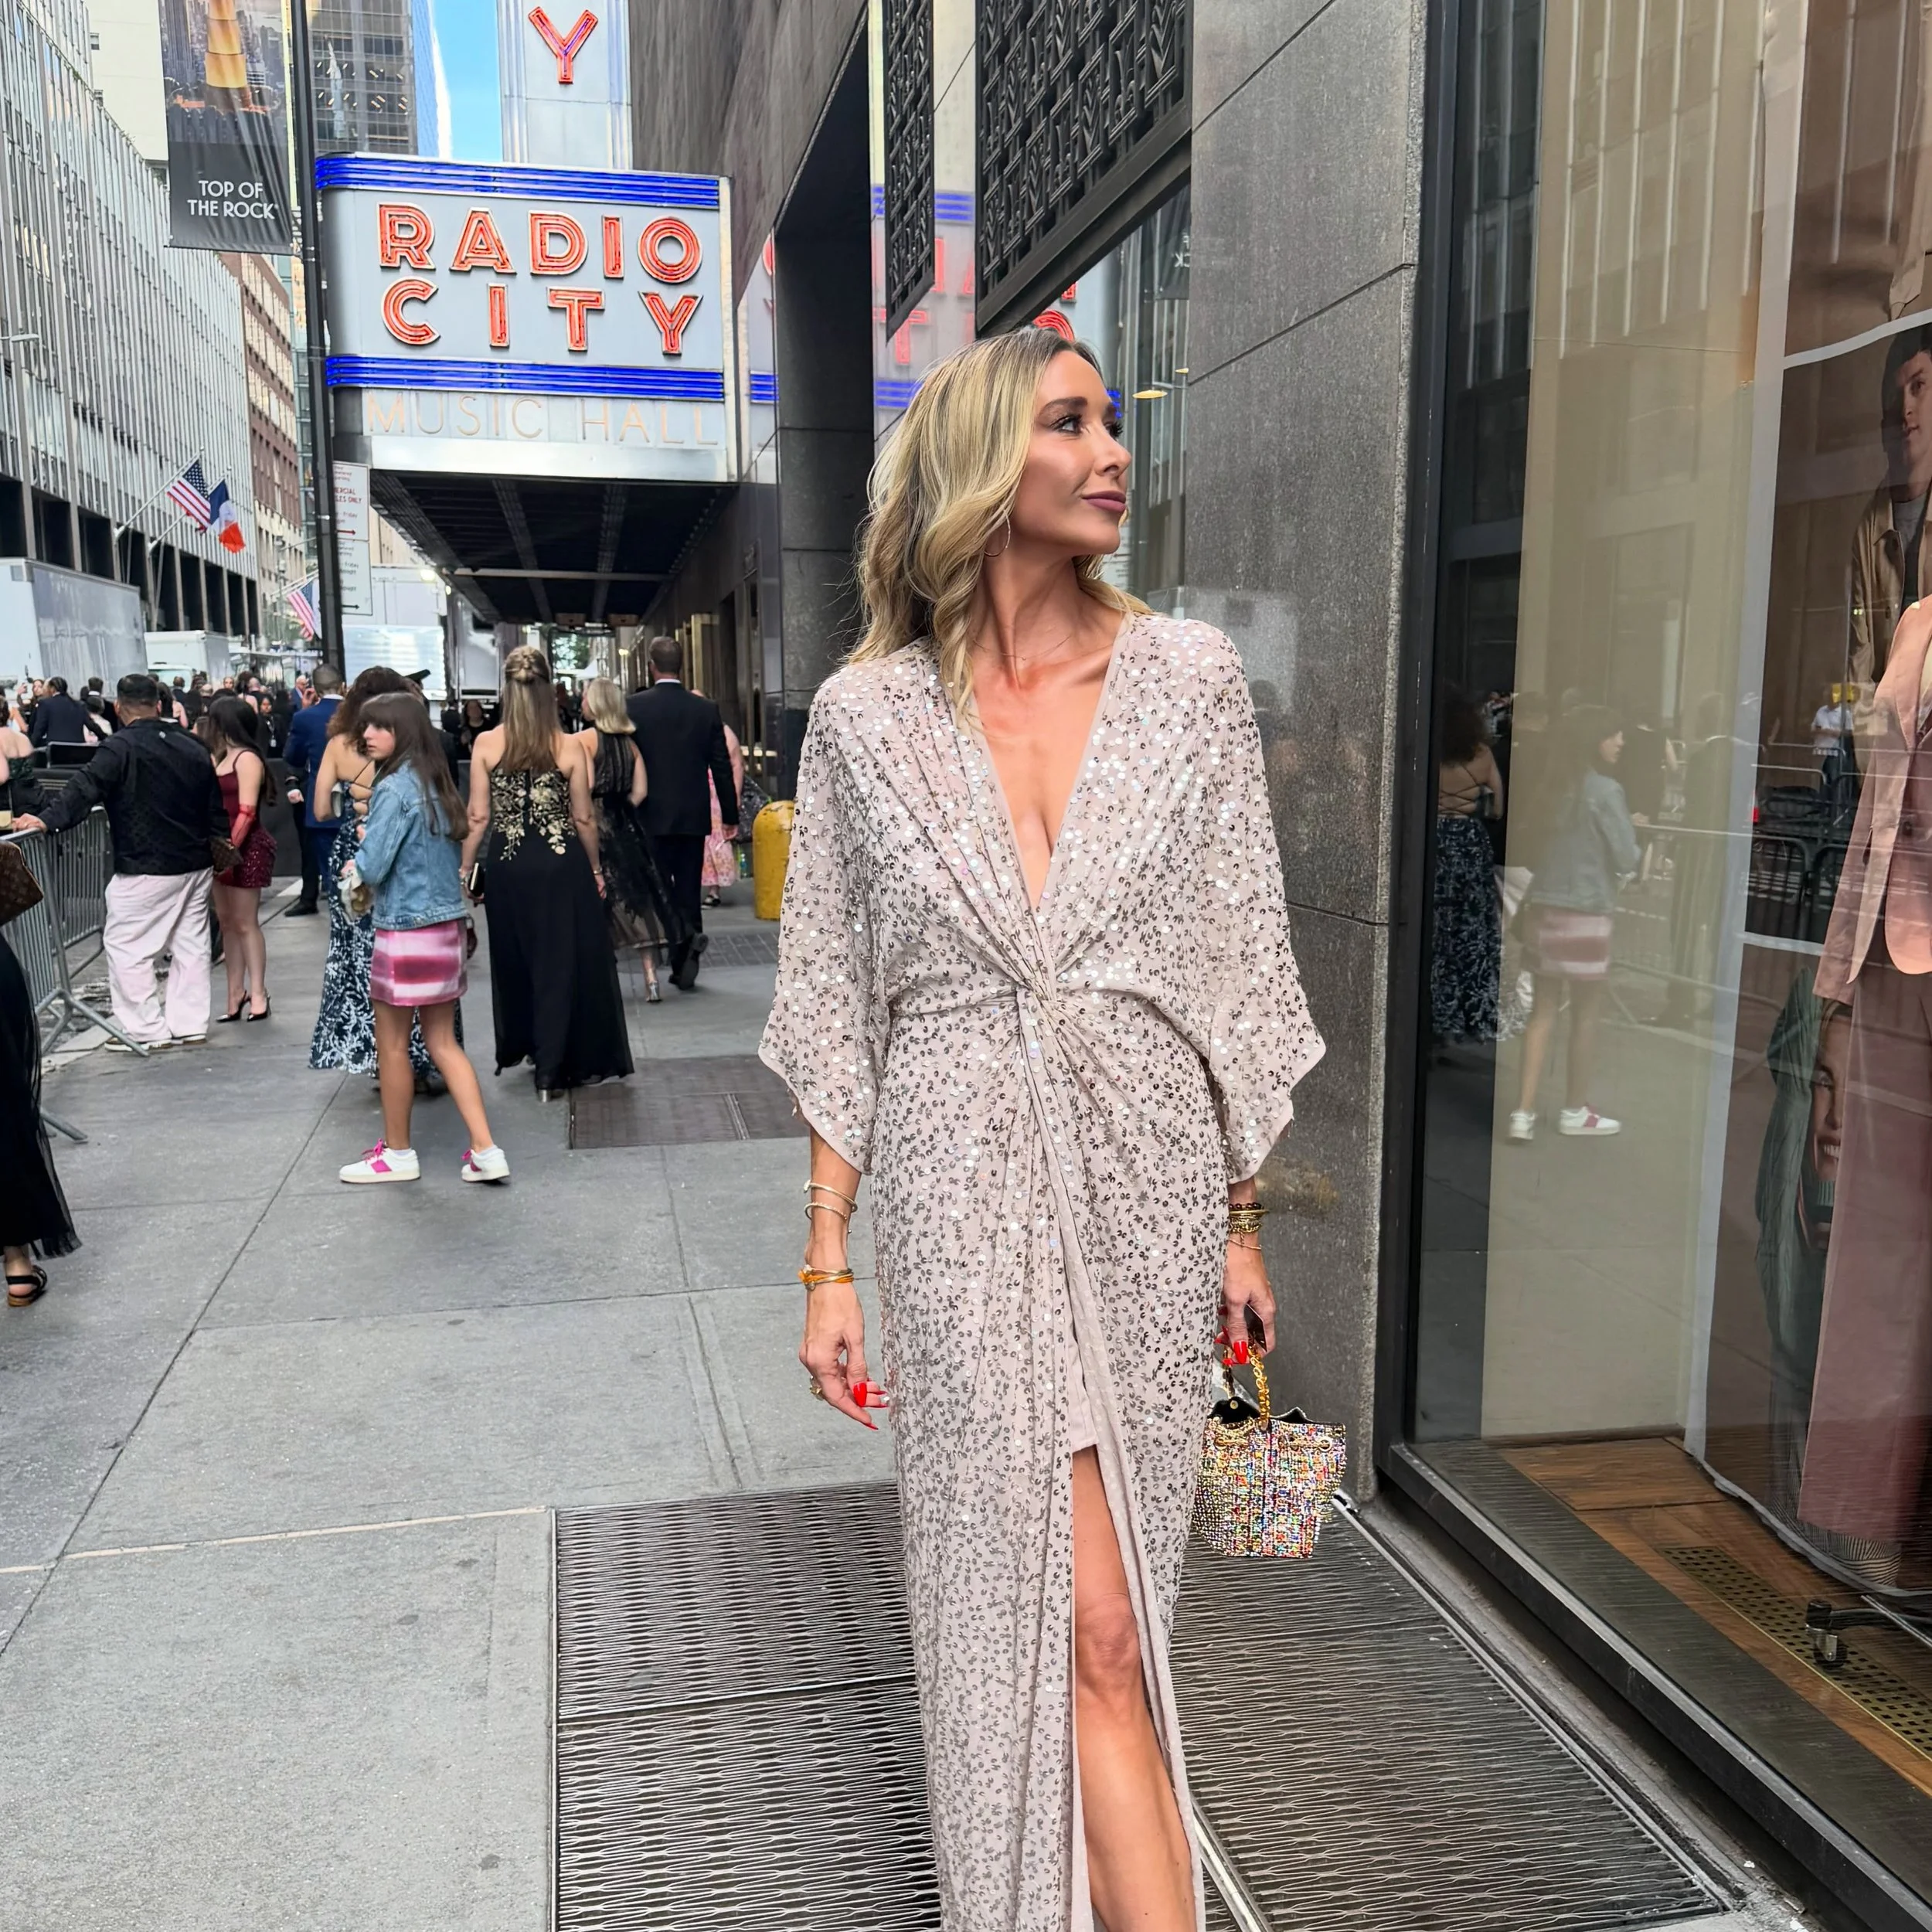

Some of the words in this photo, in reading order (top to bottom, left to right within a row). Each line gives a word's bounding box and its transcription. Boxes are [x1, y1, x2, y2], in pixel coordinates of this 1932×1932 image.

[187, 199, 219, 216] THE
[223, 201, 275, 219] ROCK
[198, 180, 234, 197] TOP
[238, 182, 263, 199] OF
[376, 202, 702, 284] RADIO
[381, 276, 704, 355] CITY
[366, 393, 543, 438] MUSIC
[580, 398, 718, 446] HALL
